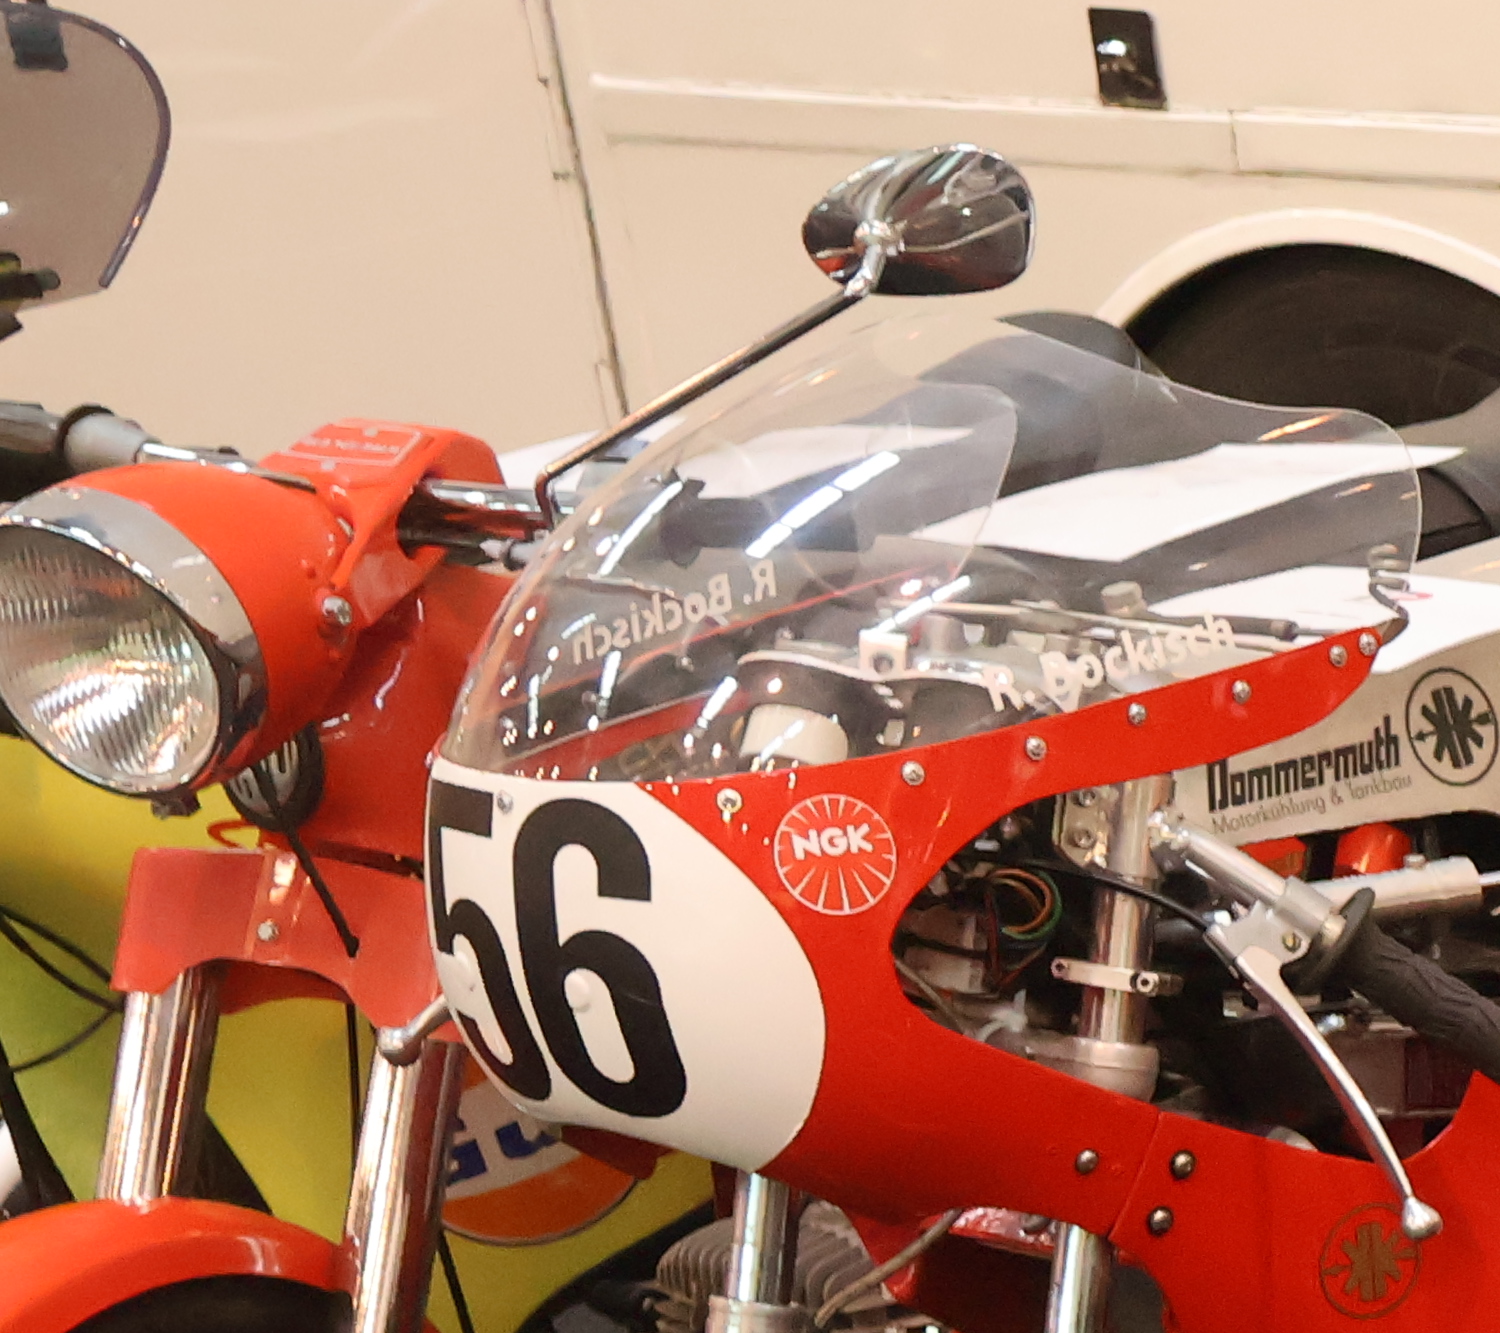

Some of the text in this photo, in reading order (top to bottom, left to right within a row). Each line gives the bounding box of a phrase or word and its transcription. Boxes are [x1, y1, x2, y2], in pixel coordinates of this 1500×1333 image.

[982, 609, 1236, 712] R. Bockisch
[1329, 786, 1345, 806] &
[791, 823, 875, 861] NGK
[429, 784, 687, 1119] 56
